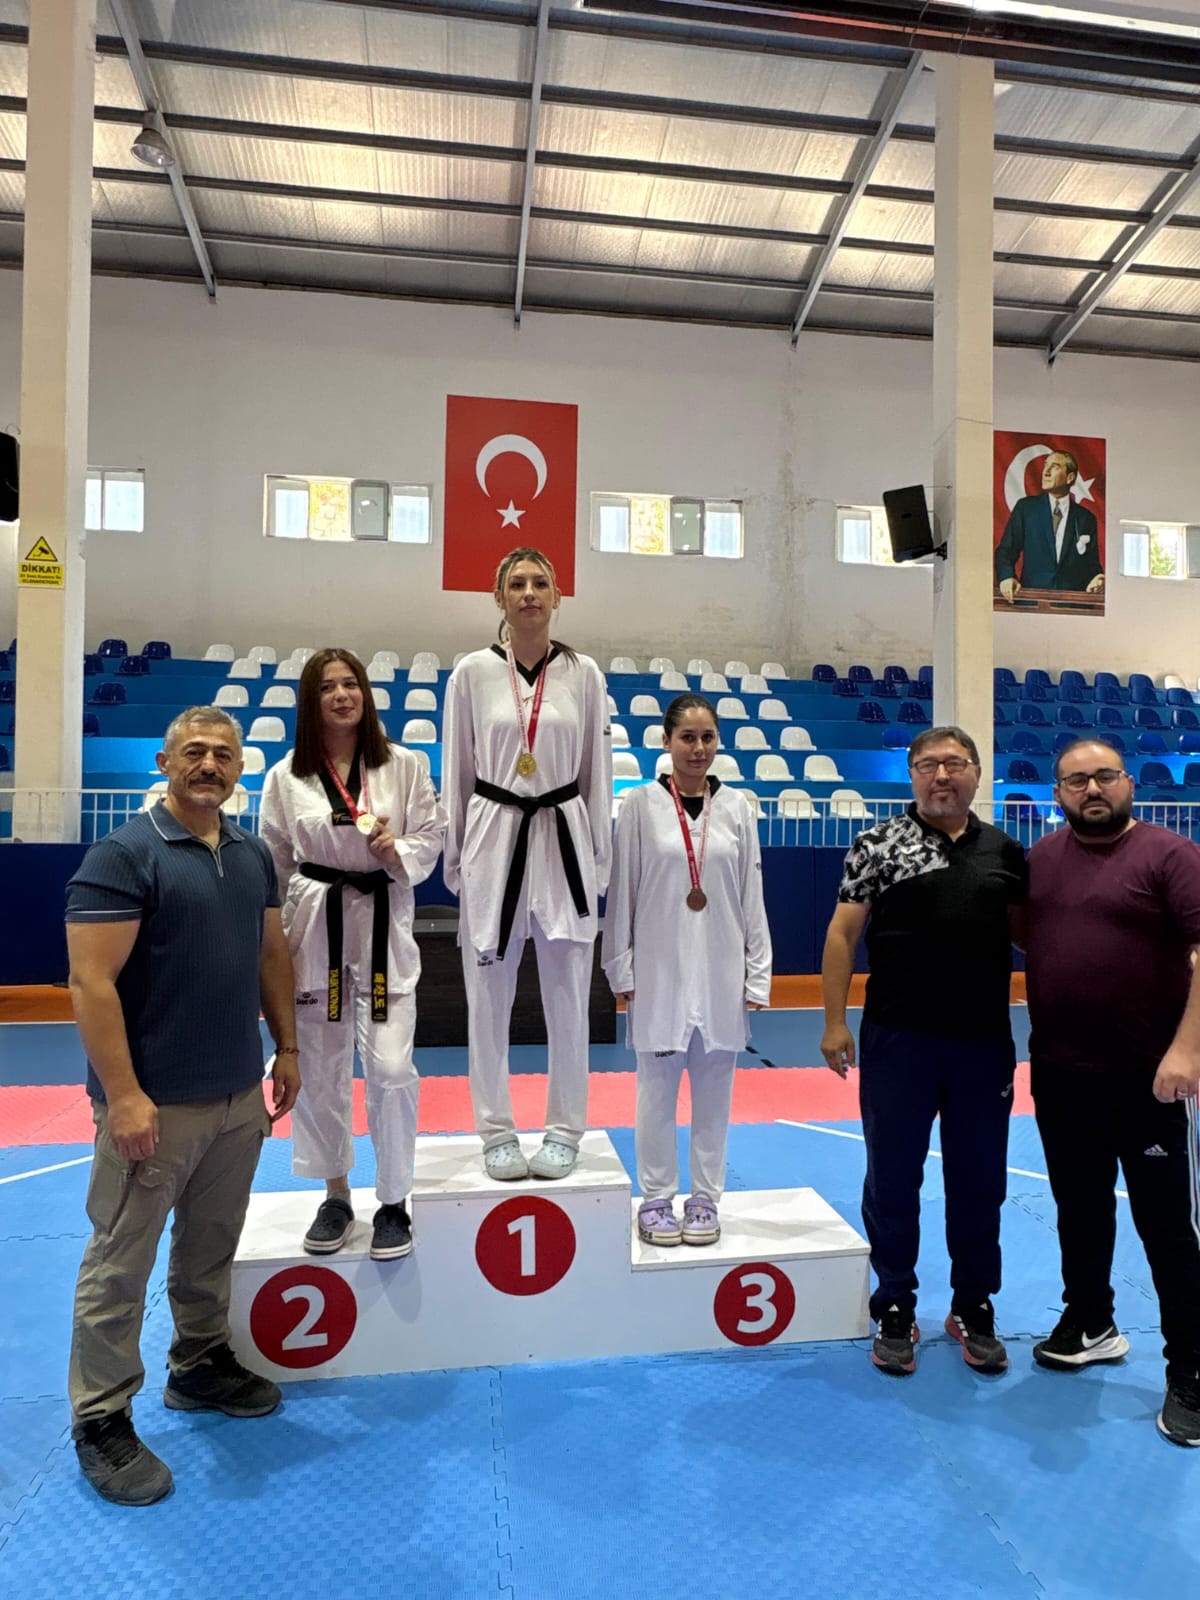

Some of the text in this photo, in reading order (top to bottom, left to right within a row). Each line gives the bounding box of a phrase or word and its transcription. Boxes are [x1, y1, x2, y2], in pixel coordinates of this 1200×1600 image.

[21, 563, 60, 573] DİKKAT!
[330, 969, 338, 1019] TAEKWONDO
[508, 1216, 536, 1276] 1
[281, 1285, 328, 1351] 2
[737, 1273, 777, 1333] 3
